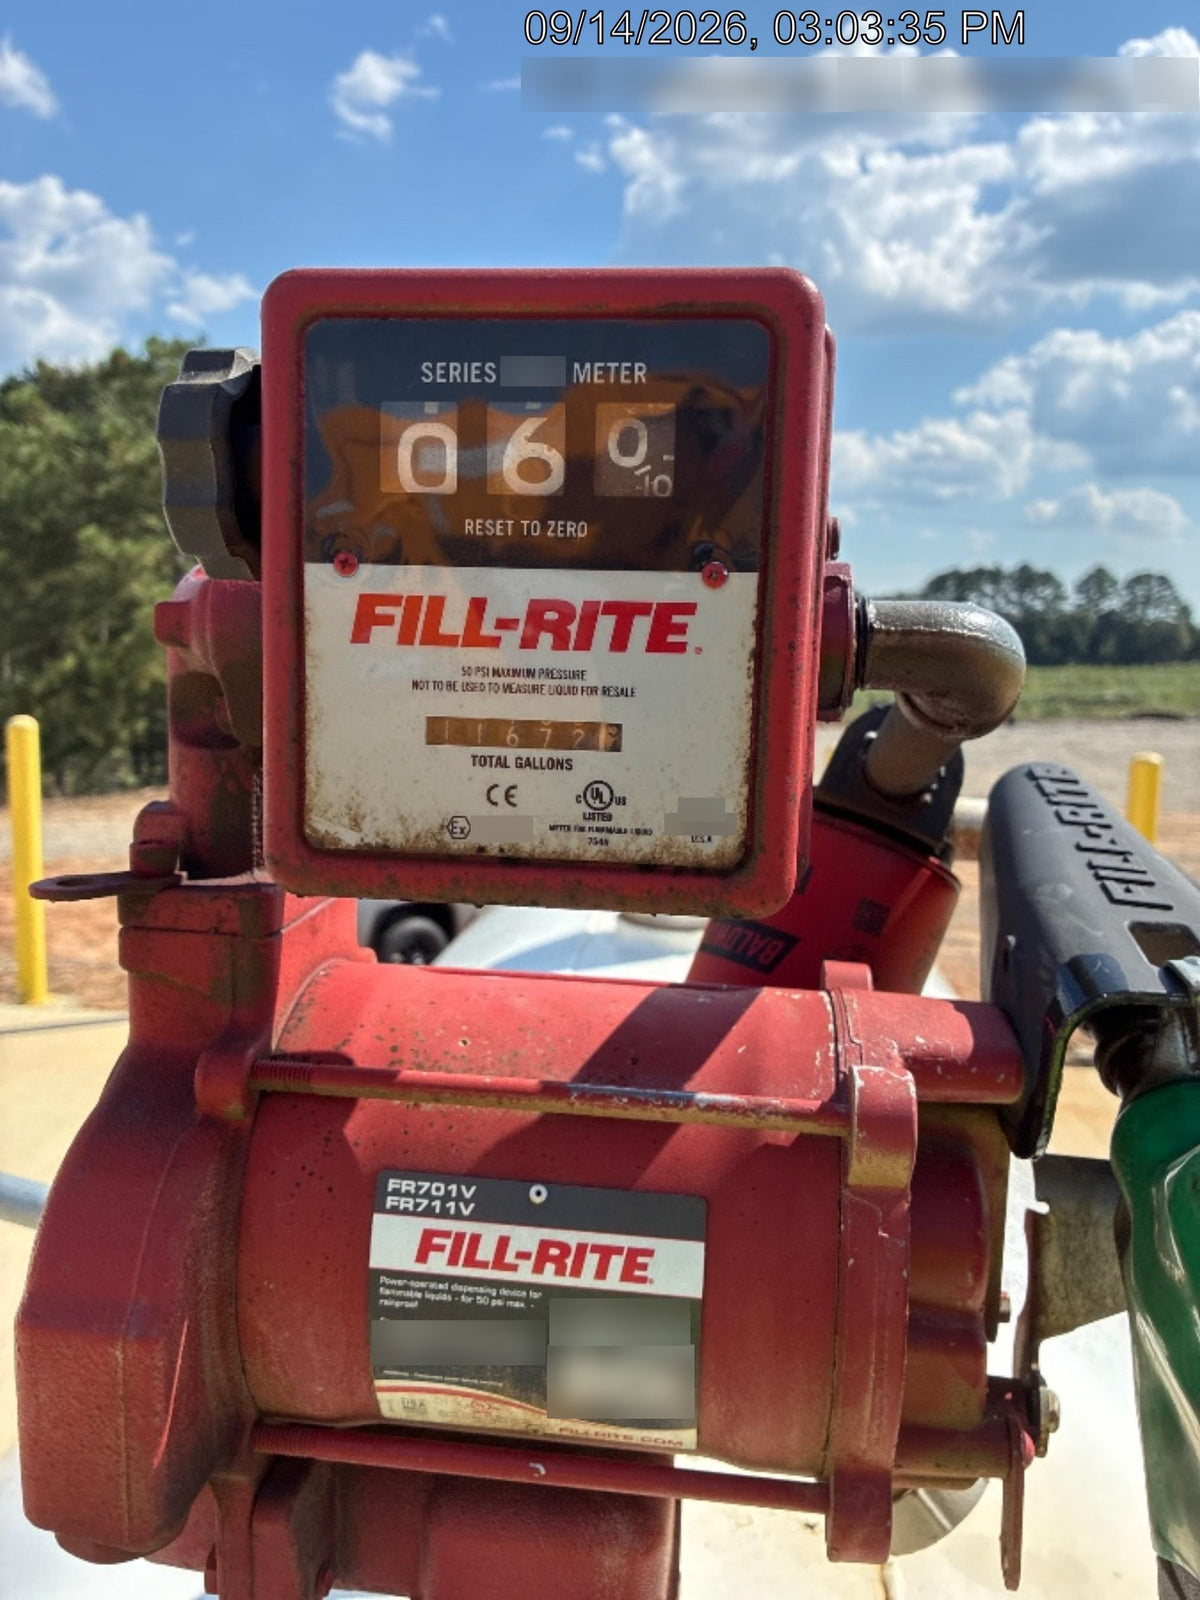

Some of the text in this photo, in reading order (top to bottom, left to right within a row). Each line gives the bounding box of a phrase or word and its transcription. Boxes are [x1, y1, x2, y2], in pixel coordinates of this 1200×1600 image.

[421, 362, 648, 384] SERIES METER
[465, 519, 588, 539] RESET TO ZERO
[350, 593, 698, 655] FILL-RITE
[461, 666, 474, 677] 50
[475, 666, 490, 678] PSI
[538, 668, 588, 681] PRESSURE
[412, 680, 636, 698] NOT TO BE USED TO MEASURE LIQUID FOR RESALE
[471, 755, 573, 771] TOTAL GALLONS
[583, 813, 612, 822] LISTED
[387, 1179, 477, 1199] FR701V
[385, 1197, 475, 1217] FR711V
[414, 1228, 655, 1285] FILL-RITE
[450, 1283, 497, 1297] dispensing
[499, 1288, 527, 1299] device
[529, 1290, 543, 1299] for
[475, 1295, 490, 1306] 50
